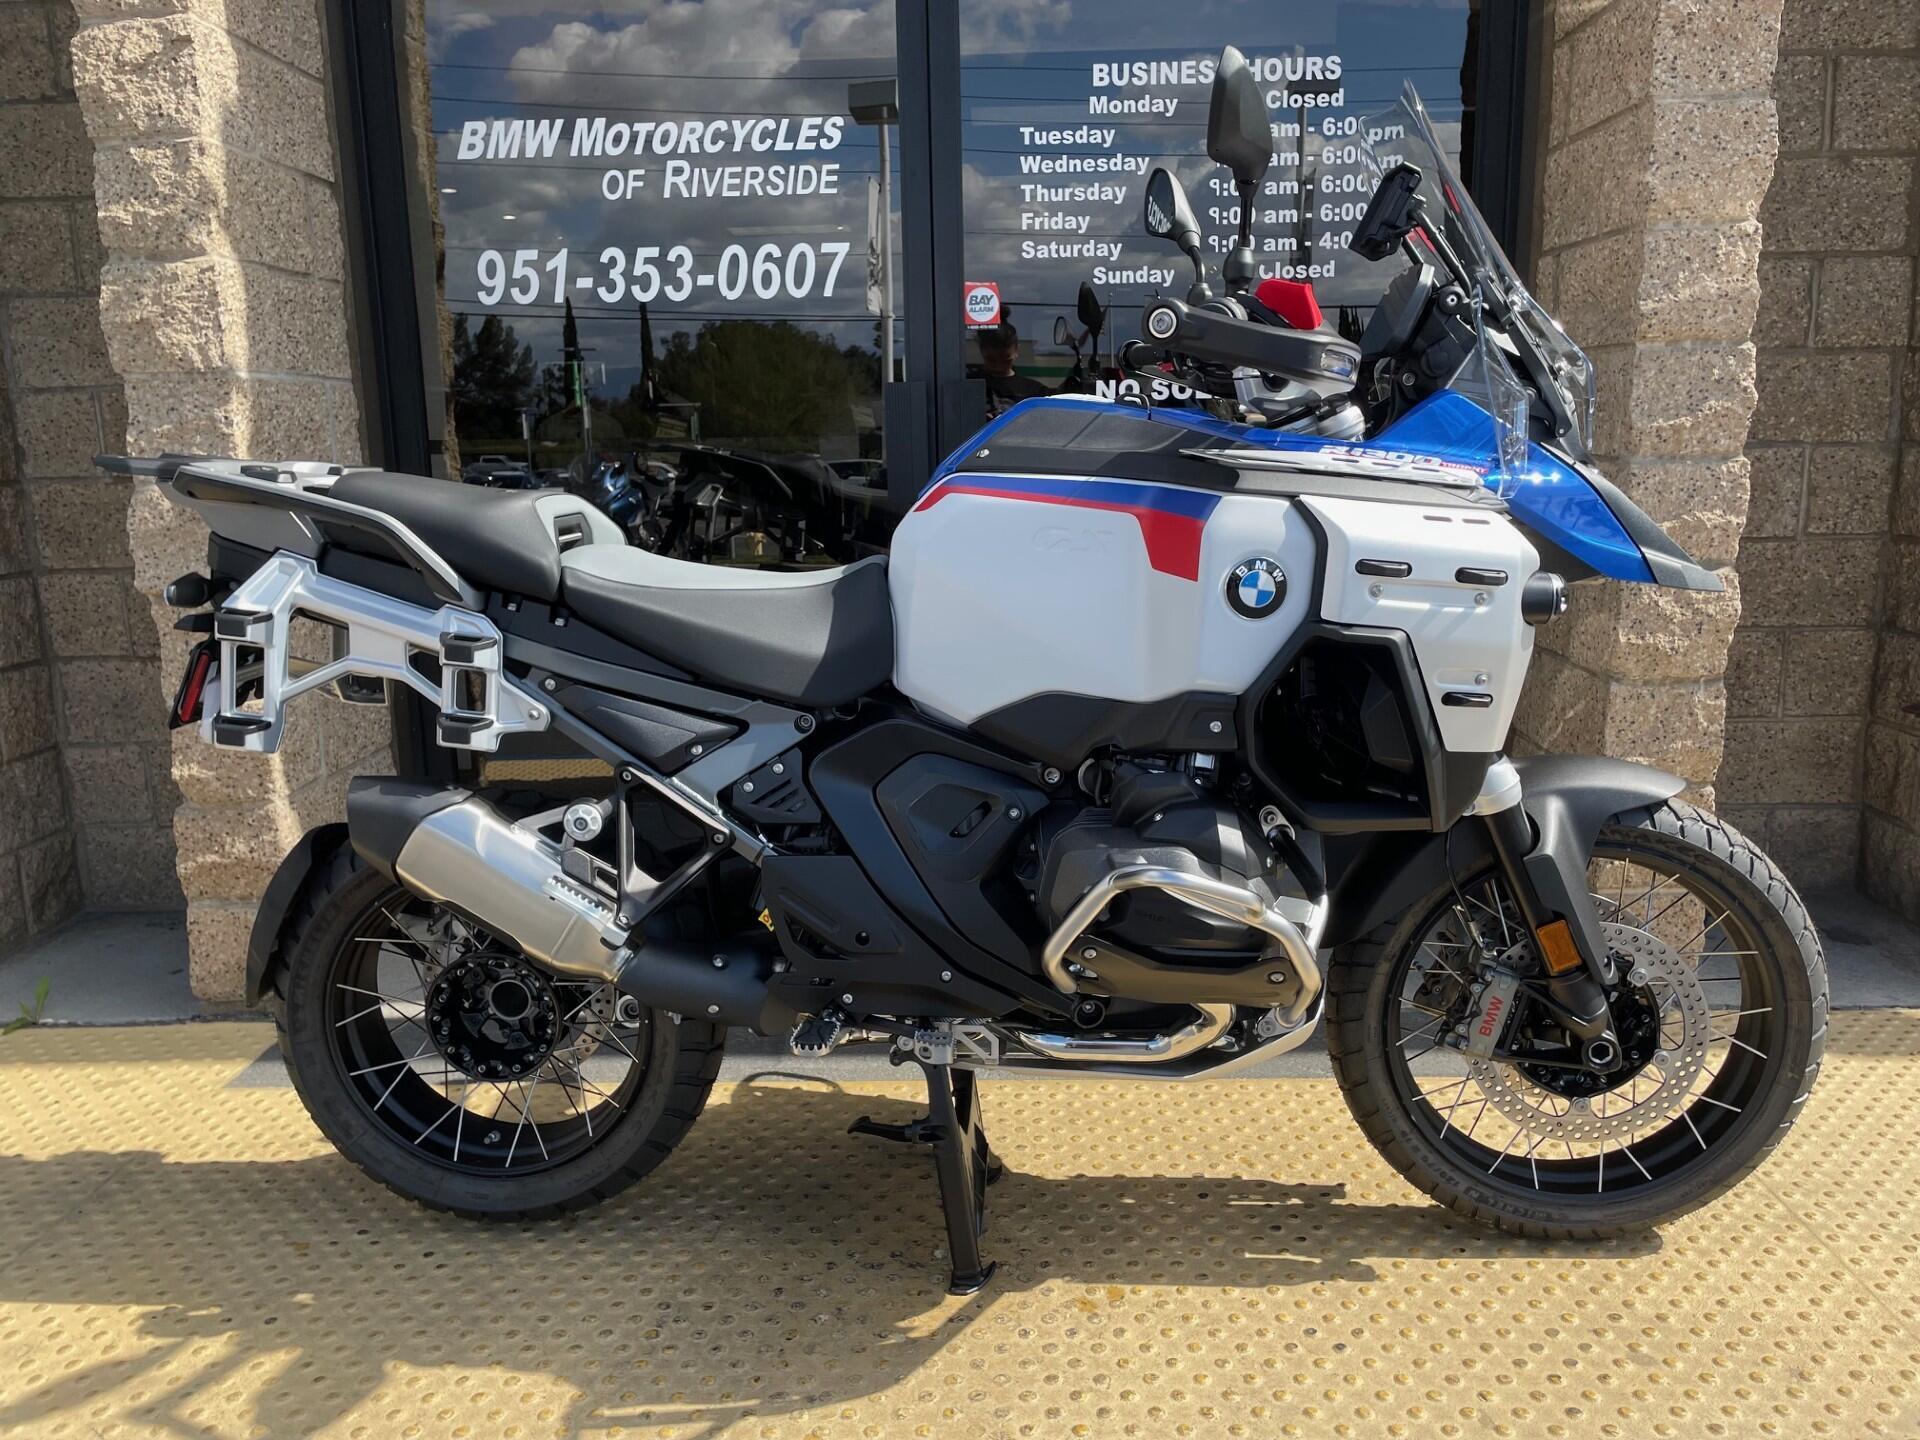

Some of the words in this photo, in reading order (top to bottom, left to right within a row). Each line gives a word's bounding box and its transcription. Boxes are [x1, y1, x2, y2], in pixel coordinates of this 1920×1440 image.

[1092, 59, 1220, 87] BUSINES
[1245, 55, 1342, 82] HOURS
[1089, 94, 1178, 117] Monday
[1265, 88, 1345, 109] Closed
[457, 118, 564, 160] BMW
[570, 116, 844, 157] MOTORCYCLES
[1019, 125, 1115, 148] Tuesday
[1322, 116, 1361, 136] 6:0
[1368, 124, 1405, 146] pm
[1019, 153, 1150, 175] Wednesday
[1322, 145, 1361, 165] 6:0
[602, 169, 645, 200] OF
[663, 159, 840, 199] RIVERSIDE
[1020, 182, 1127, 205] Thursday
[1264, 180, 1299, 195] am
[1321, 174, 1367, 193] 6:00
[1021, 211, 1090, 233] Friday
[1263, 209, 1298, 224] am
[1320, 203, 1368, 222] 6:00
[1021, 239, 1122, 261] Saturday
[1263, 238, 1298, 252] am
[477, 242, 850, 306] 951-353-0607
[1092, 265, 1175, 287] Sunday
[1258, 260, 1336, 280] Closed
[969, 294, 995, 306] BAY
[1096, 379, 1140, 400] NO
[1235, 559, 1285, 583] BMW
[1478, 995, 1505, 1037] BMW
